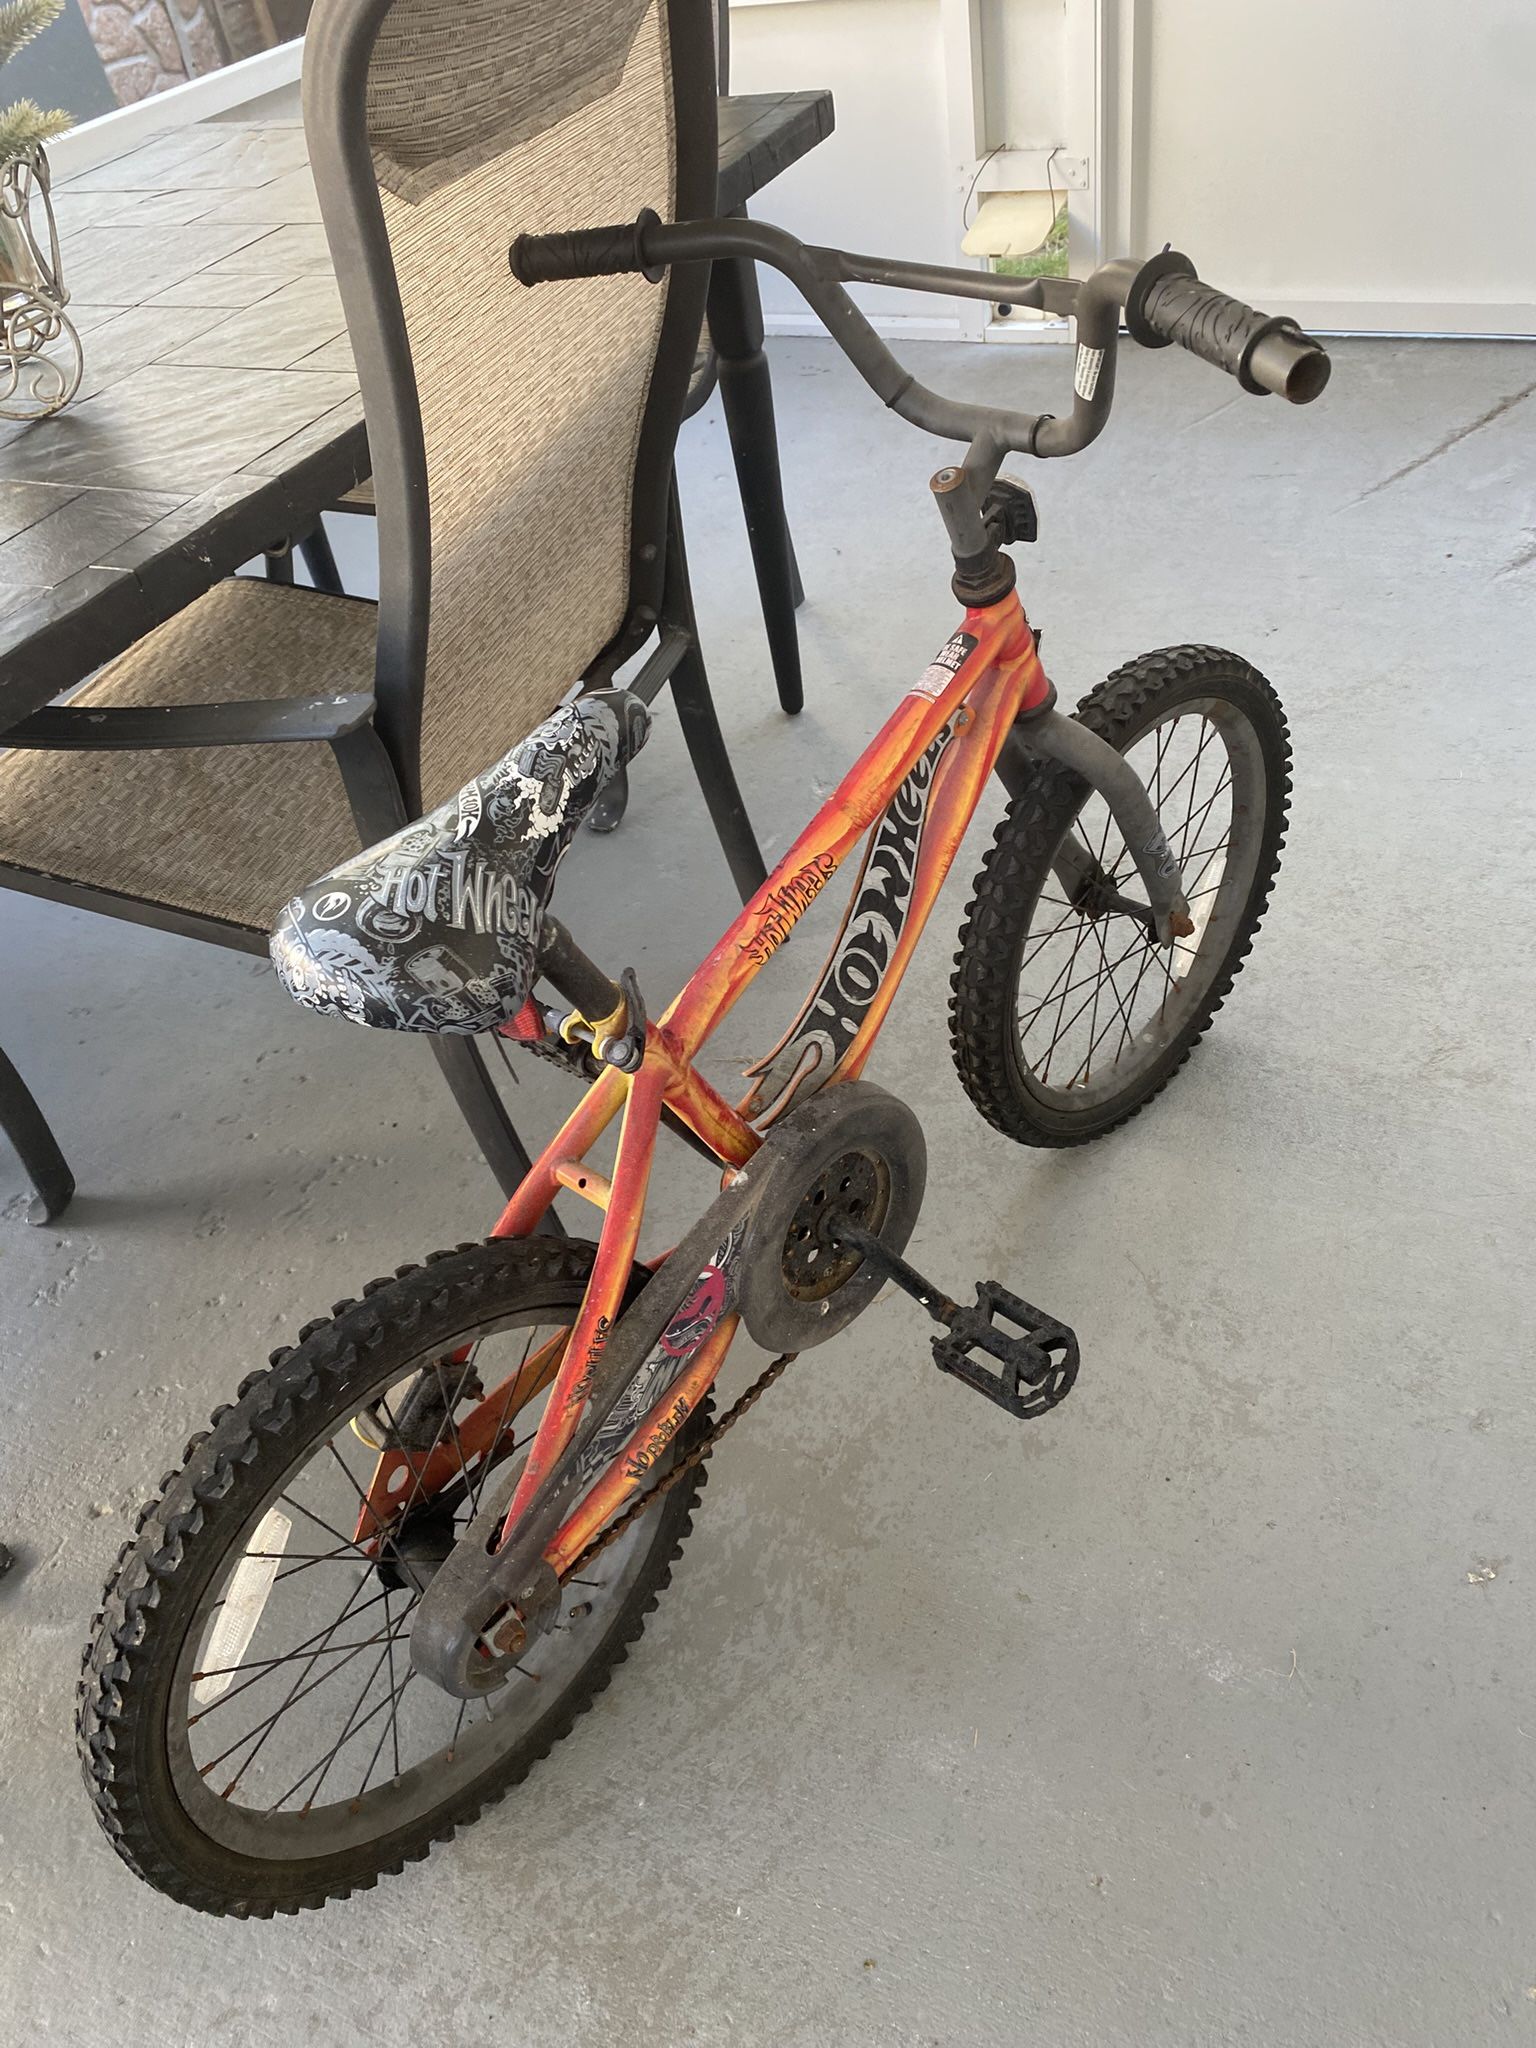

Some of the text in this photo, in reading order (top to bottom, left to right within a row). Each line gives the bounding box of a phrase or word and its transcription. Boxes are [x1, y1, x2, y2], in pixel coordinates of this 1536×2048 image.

[951, 644, 968, 656] SAFE
[370, 862, 448, 923] Hot
[739, 913, 787, 966] Hot
[787, 918, 888, 1062] HOT
[624, 1451, 650, 1477] NO
